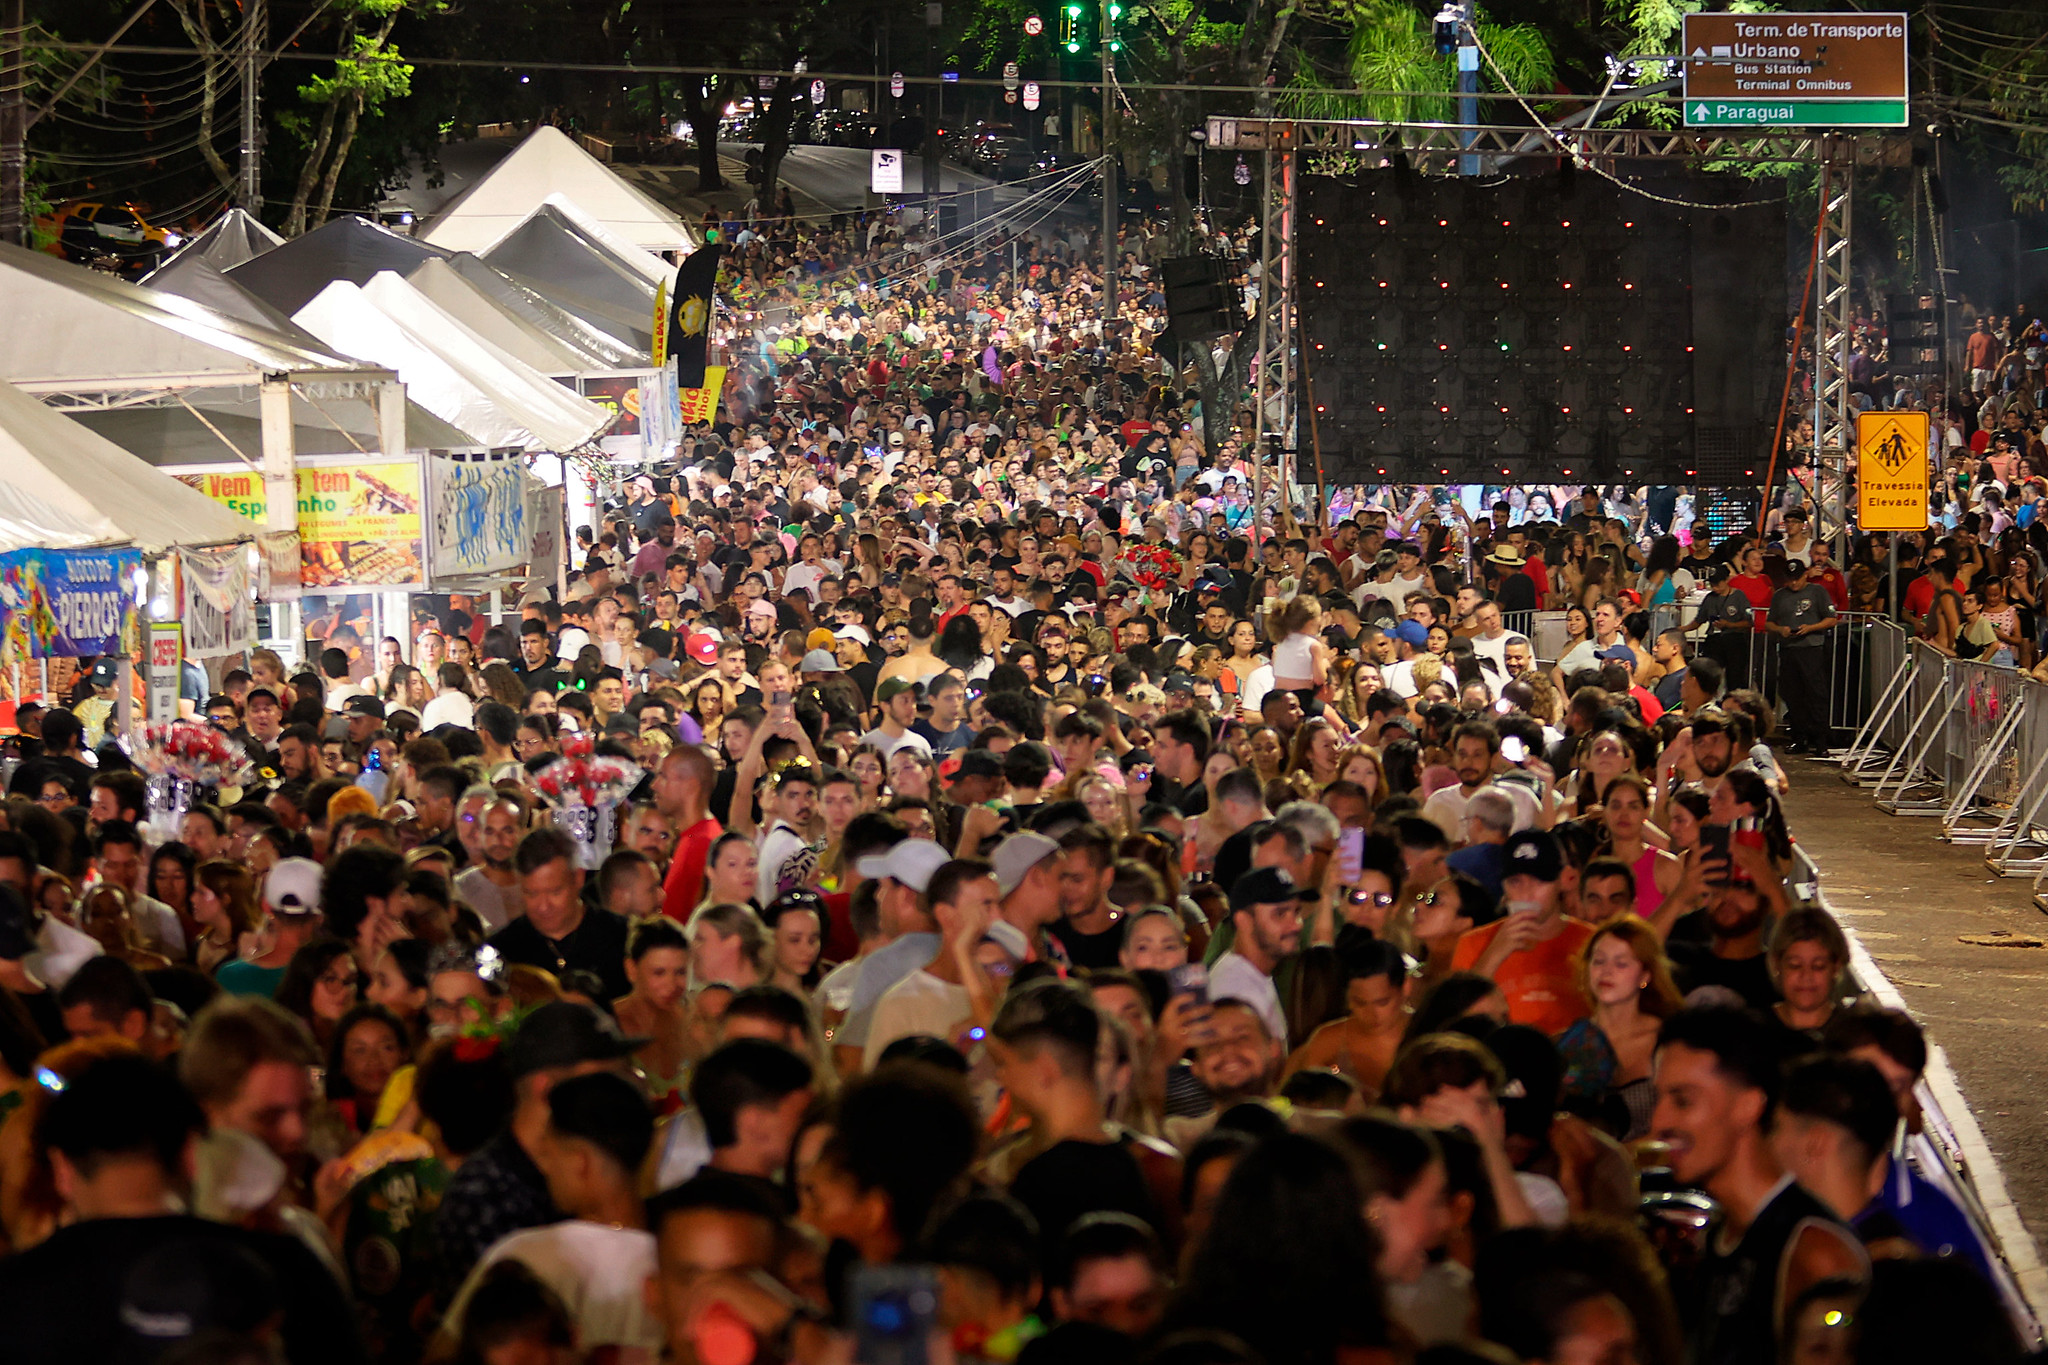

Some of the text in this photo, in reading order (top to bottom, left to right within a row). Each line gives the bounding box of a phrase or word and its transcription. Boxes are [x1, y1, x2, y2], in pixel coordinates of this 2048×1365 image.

[1735, 22, 1903, 41] Term. de Transporte
[1734, 42, 1800, 58] Urbano
[1734, 63, 1812, 75] Bus Station
[1736, 79, 1852, 91] Terminal Omnibus
[1716, 104, 1794, 120] Paraguai
[209, 475, 251, 498] Vem
[312, 470, 350, 493] tem
[1863, 481, 1923, 491] Travessia
[1868, 497, 1918, 507] Elevada
